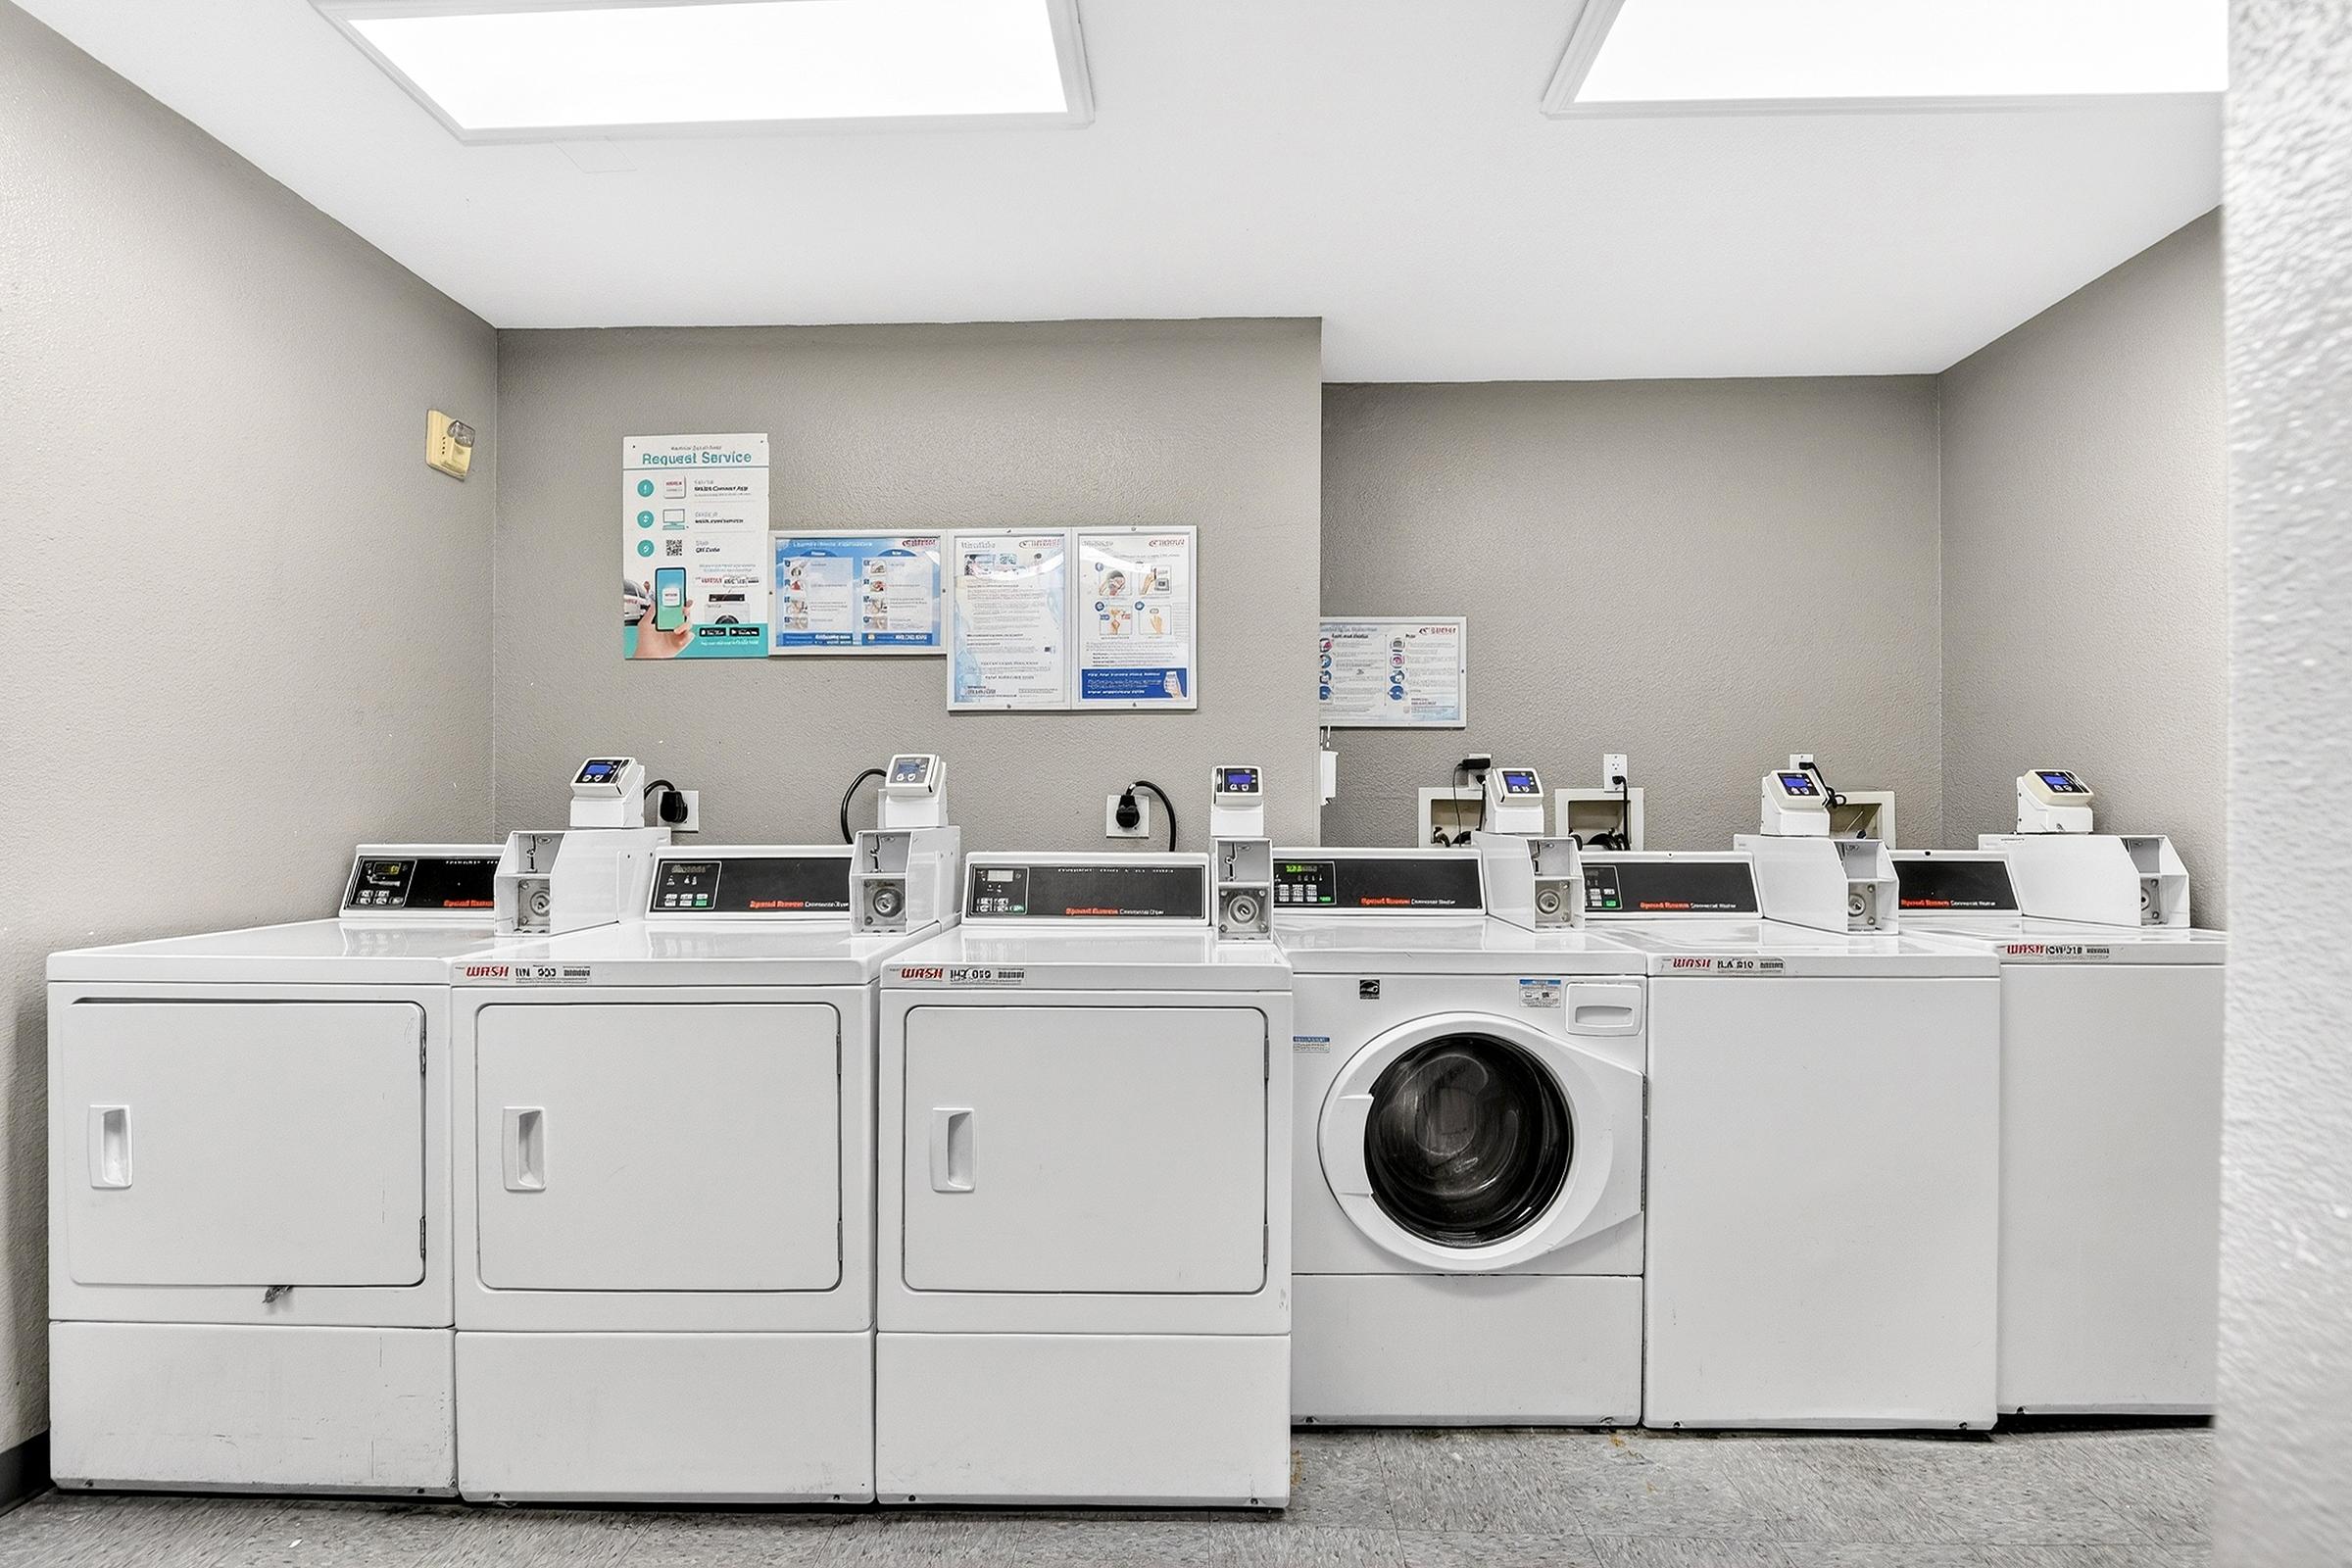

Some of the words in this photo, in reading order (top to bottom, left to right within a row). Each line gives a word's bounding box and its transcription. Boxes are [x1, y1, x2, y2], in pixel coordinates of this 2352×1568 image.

[642, 453, 697, 466] Request
[702, 451, 752, 464] Service
[466, 965, 509, 977] WASH
[902, 967, 943, 979] WASH
